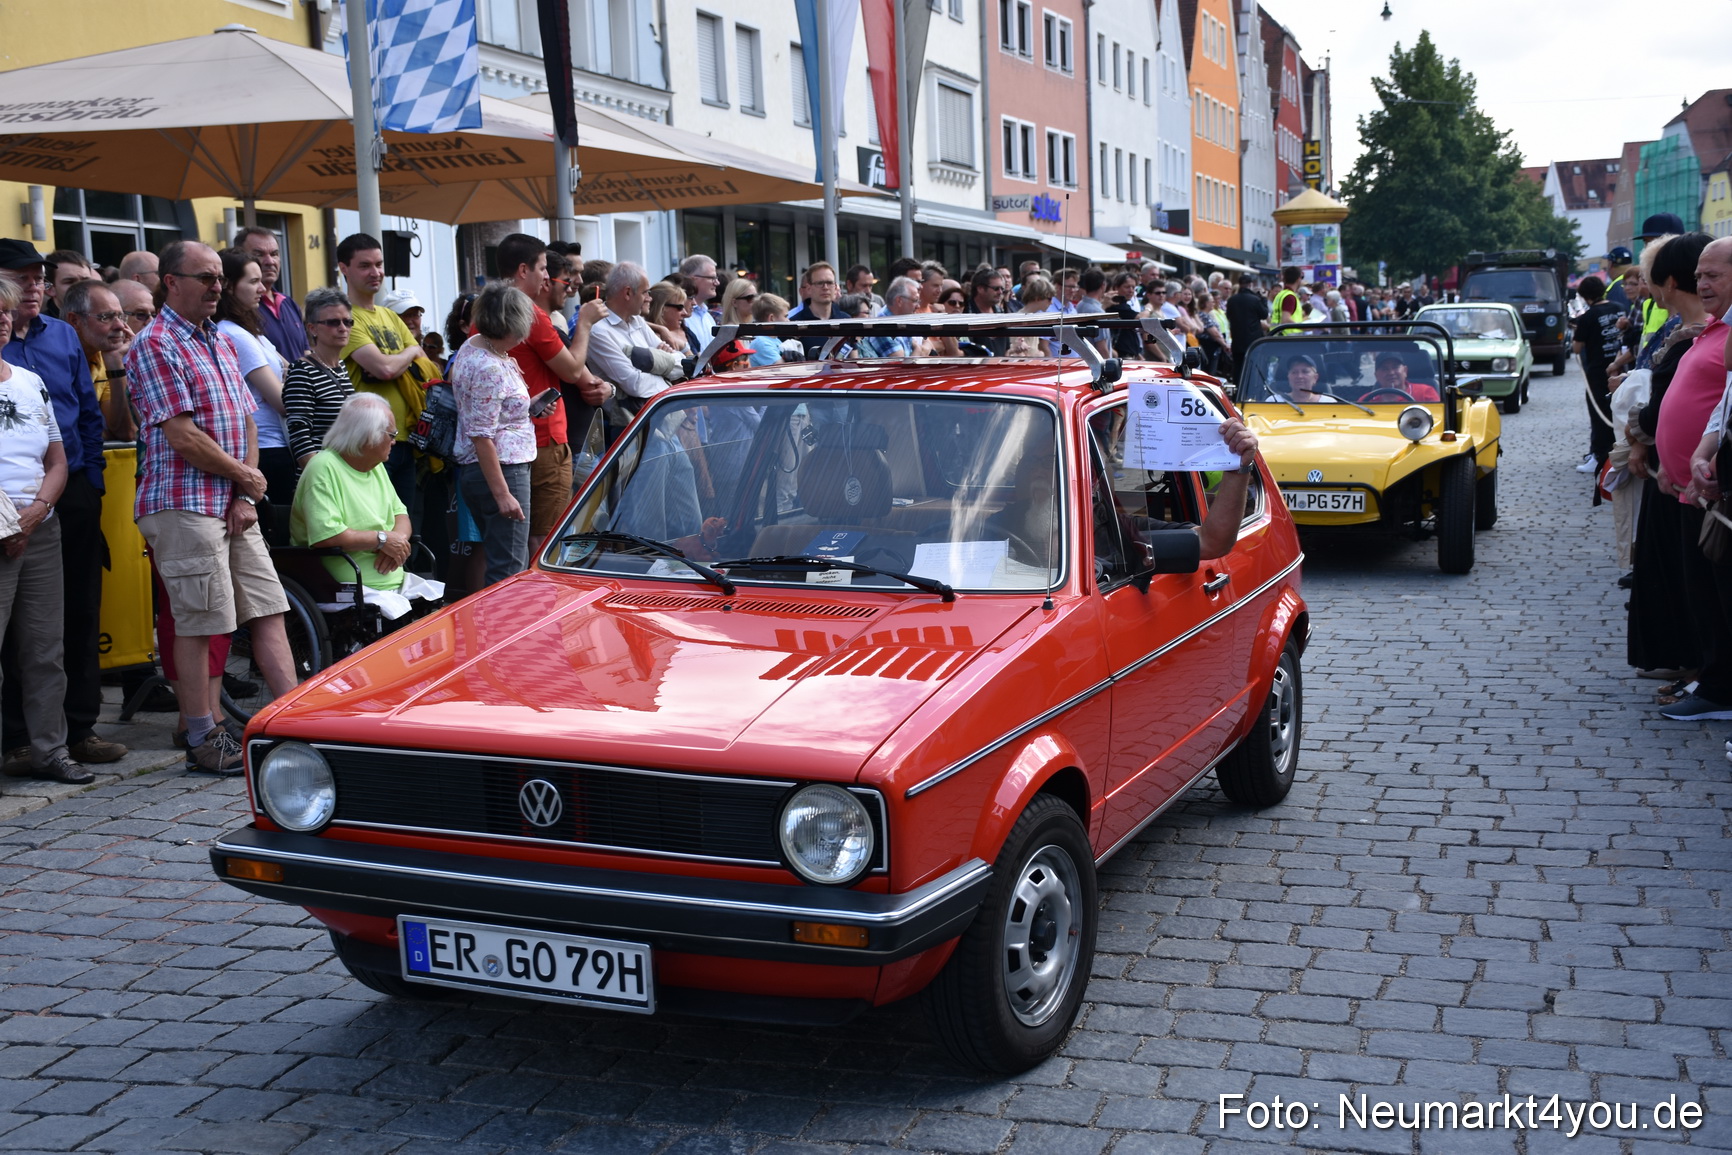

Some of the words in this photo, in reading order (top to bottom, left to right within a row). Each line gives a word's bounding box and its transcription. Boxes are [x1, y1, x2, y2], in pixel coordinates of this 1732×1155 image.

[308, 235, 320, 249] 24
[1307, 494, 1328, 509] PG
[1331, 494, 1363, 510] 57H
[415, 950, 423, 962] D
[429, 928, 479, 973] ER
[506, 938, 556, 983] GO
[566, 945, 644, 995] 79H
